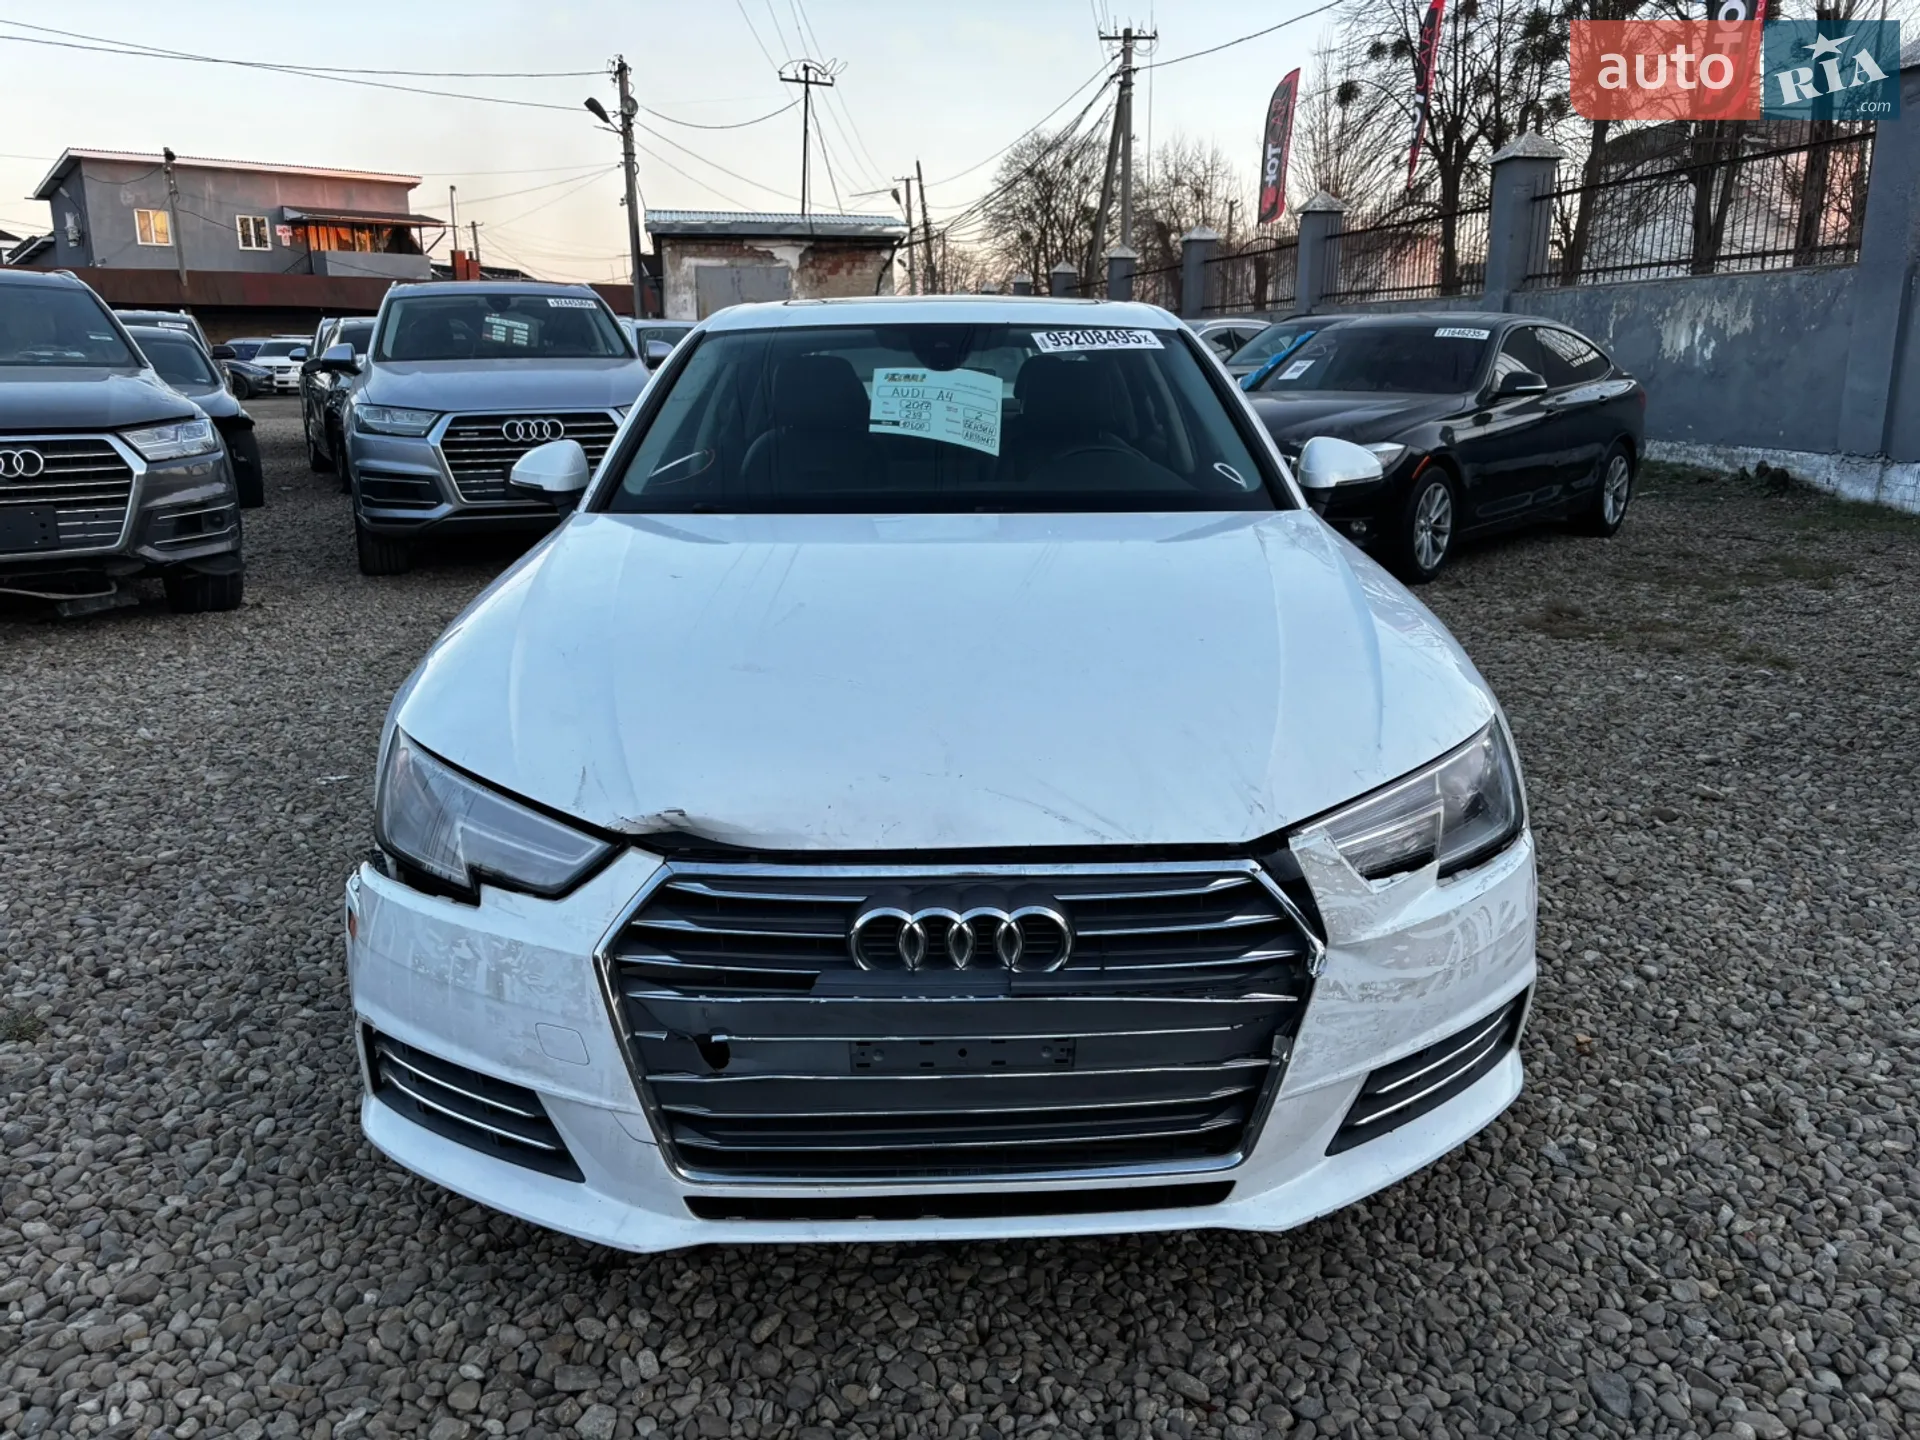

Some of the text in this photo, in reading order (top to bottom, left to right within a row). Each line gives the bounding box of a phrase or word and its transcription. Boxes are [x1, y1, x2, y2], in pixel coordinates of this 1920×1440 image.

[1046, 330, 1142, 347] 95208495
[891, 387, 954, 402] AUDI A4
